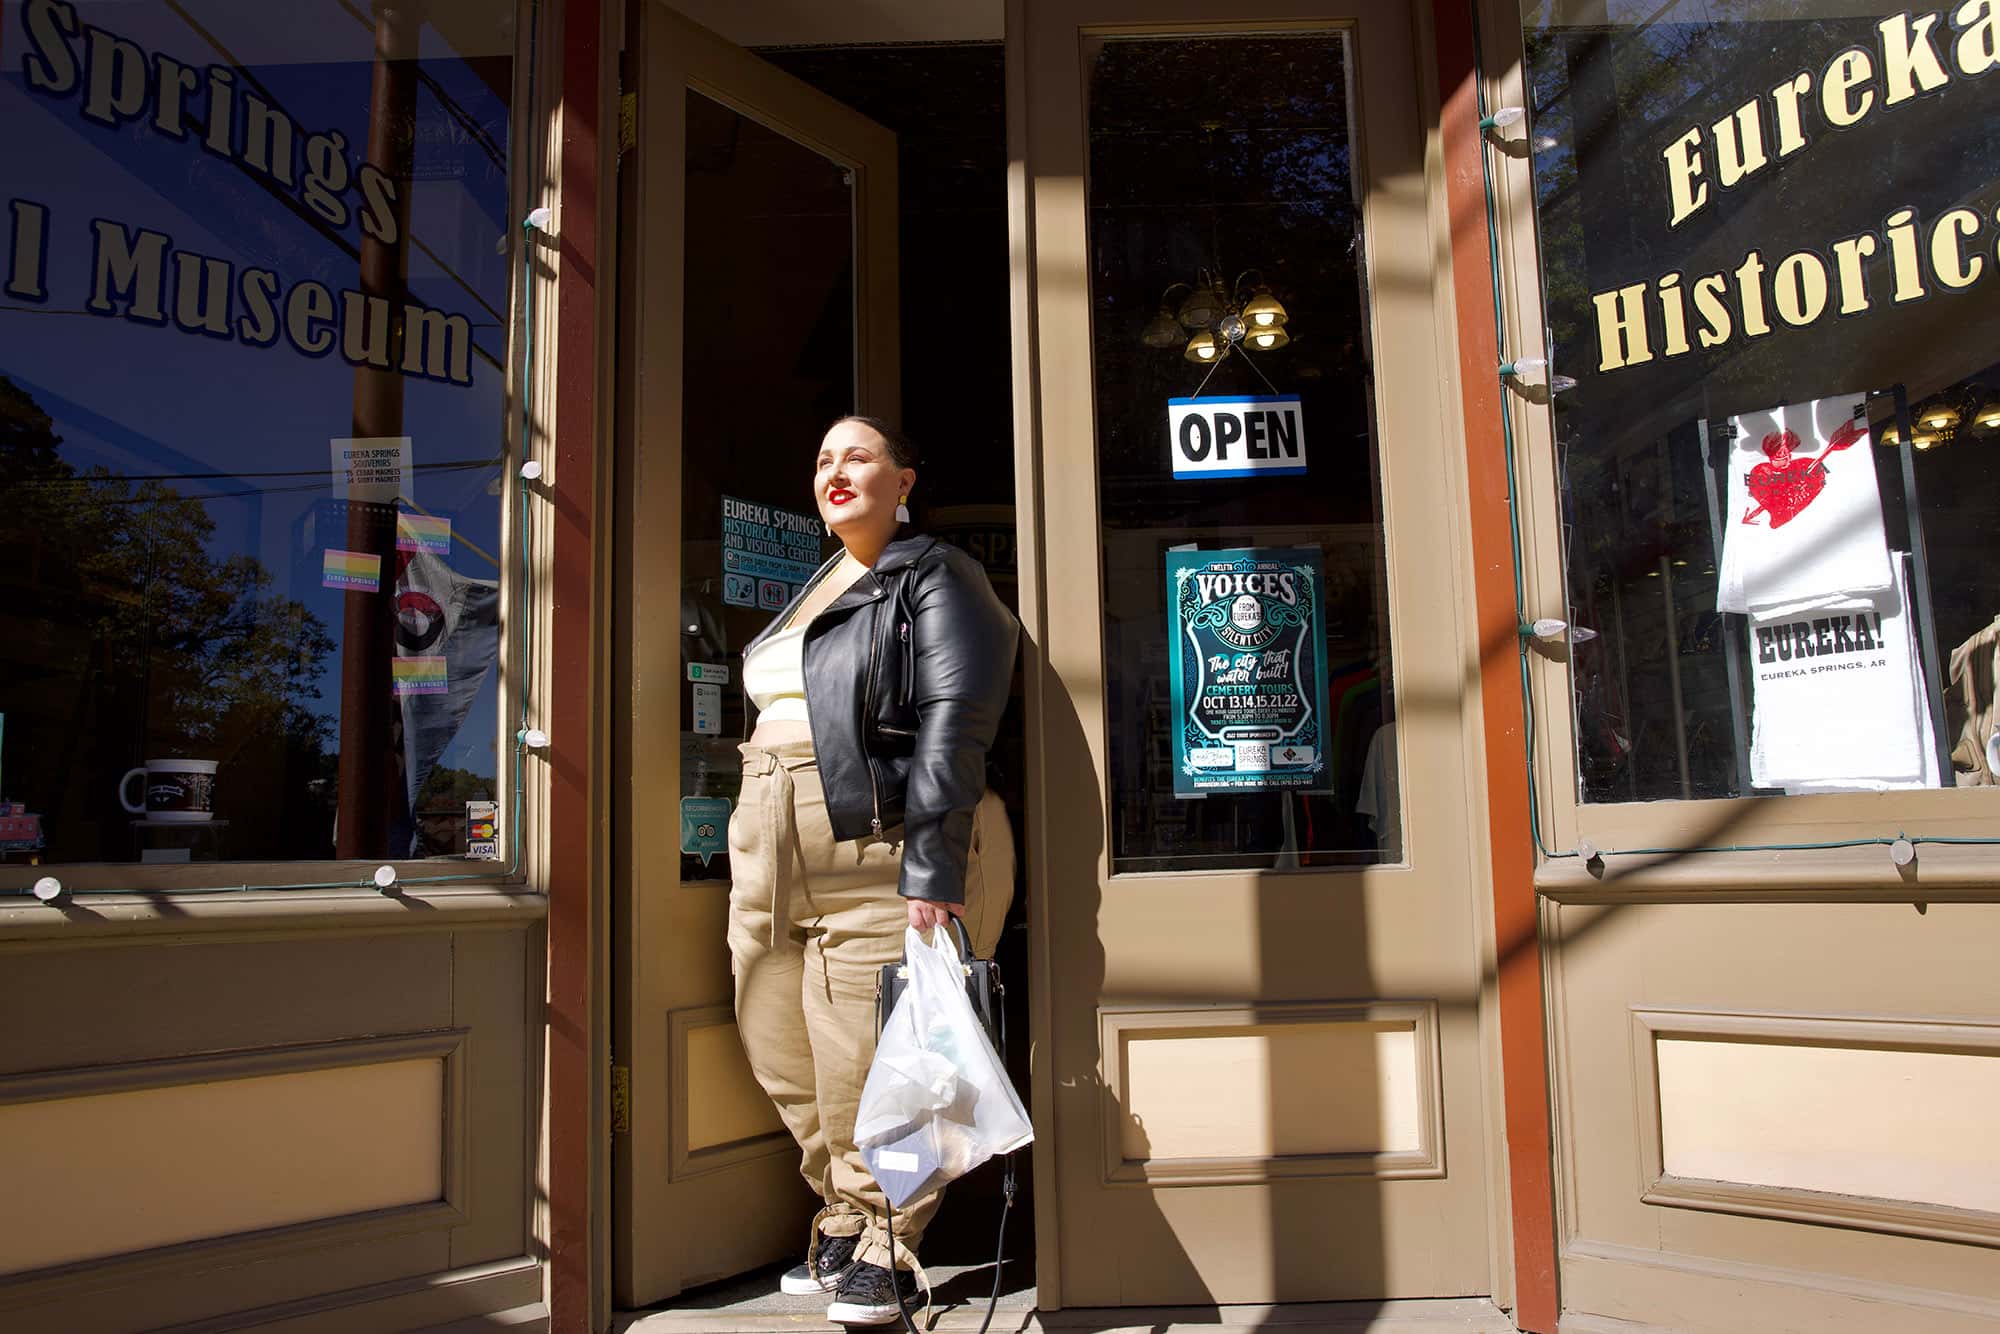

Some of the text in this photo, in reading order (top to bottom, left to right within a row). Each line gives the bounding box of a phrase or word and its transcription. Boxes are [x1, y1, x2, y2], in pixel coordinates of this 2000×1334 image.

[23, 0, 399, 245] Springs
[1660, 0, 2000, 229] Eureka
[1591, 206, 2000, 374] Historic
[88, 219, 473, 387] Museum
[1179, 410, 1298, 462] OPEN
[343, 448, 400, 459] EUREKA SPRINGS
[353, 459, 391, 468] SOUVENIRS
[1743, 463, 1830, 488] EUREKA
[723, 499, 820, 536] EUREKA SPRINGS
[723, 518, 820, 551] HISTORICAL MUSEUM
[724, 533, 820, 563] AND VISITORS CENTER
[326, 573, 377, 585] EUREKA SPRINGS
[1196, 573, 1296, 608] VOICES
[1239, 602, 1255, 611] FROM
[1221, 625, 1273, 646] SILENT CITY
[1756, 612, 1885, 664] EUREKA!
[1208, 648, 1291, 672] The city that
[1761, 669, 1807, 681] EUREKA
[1810, 662, 1866, 674] SPRINGS,
[1217, 661, 1289, 684] water built!
[1206, 684, 1294, 695] CEMETERY TOURS
[1203, 696, 1226, 709] OCT
[473, 845, 493, 854] VISA
